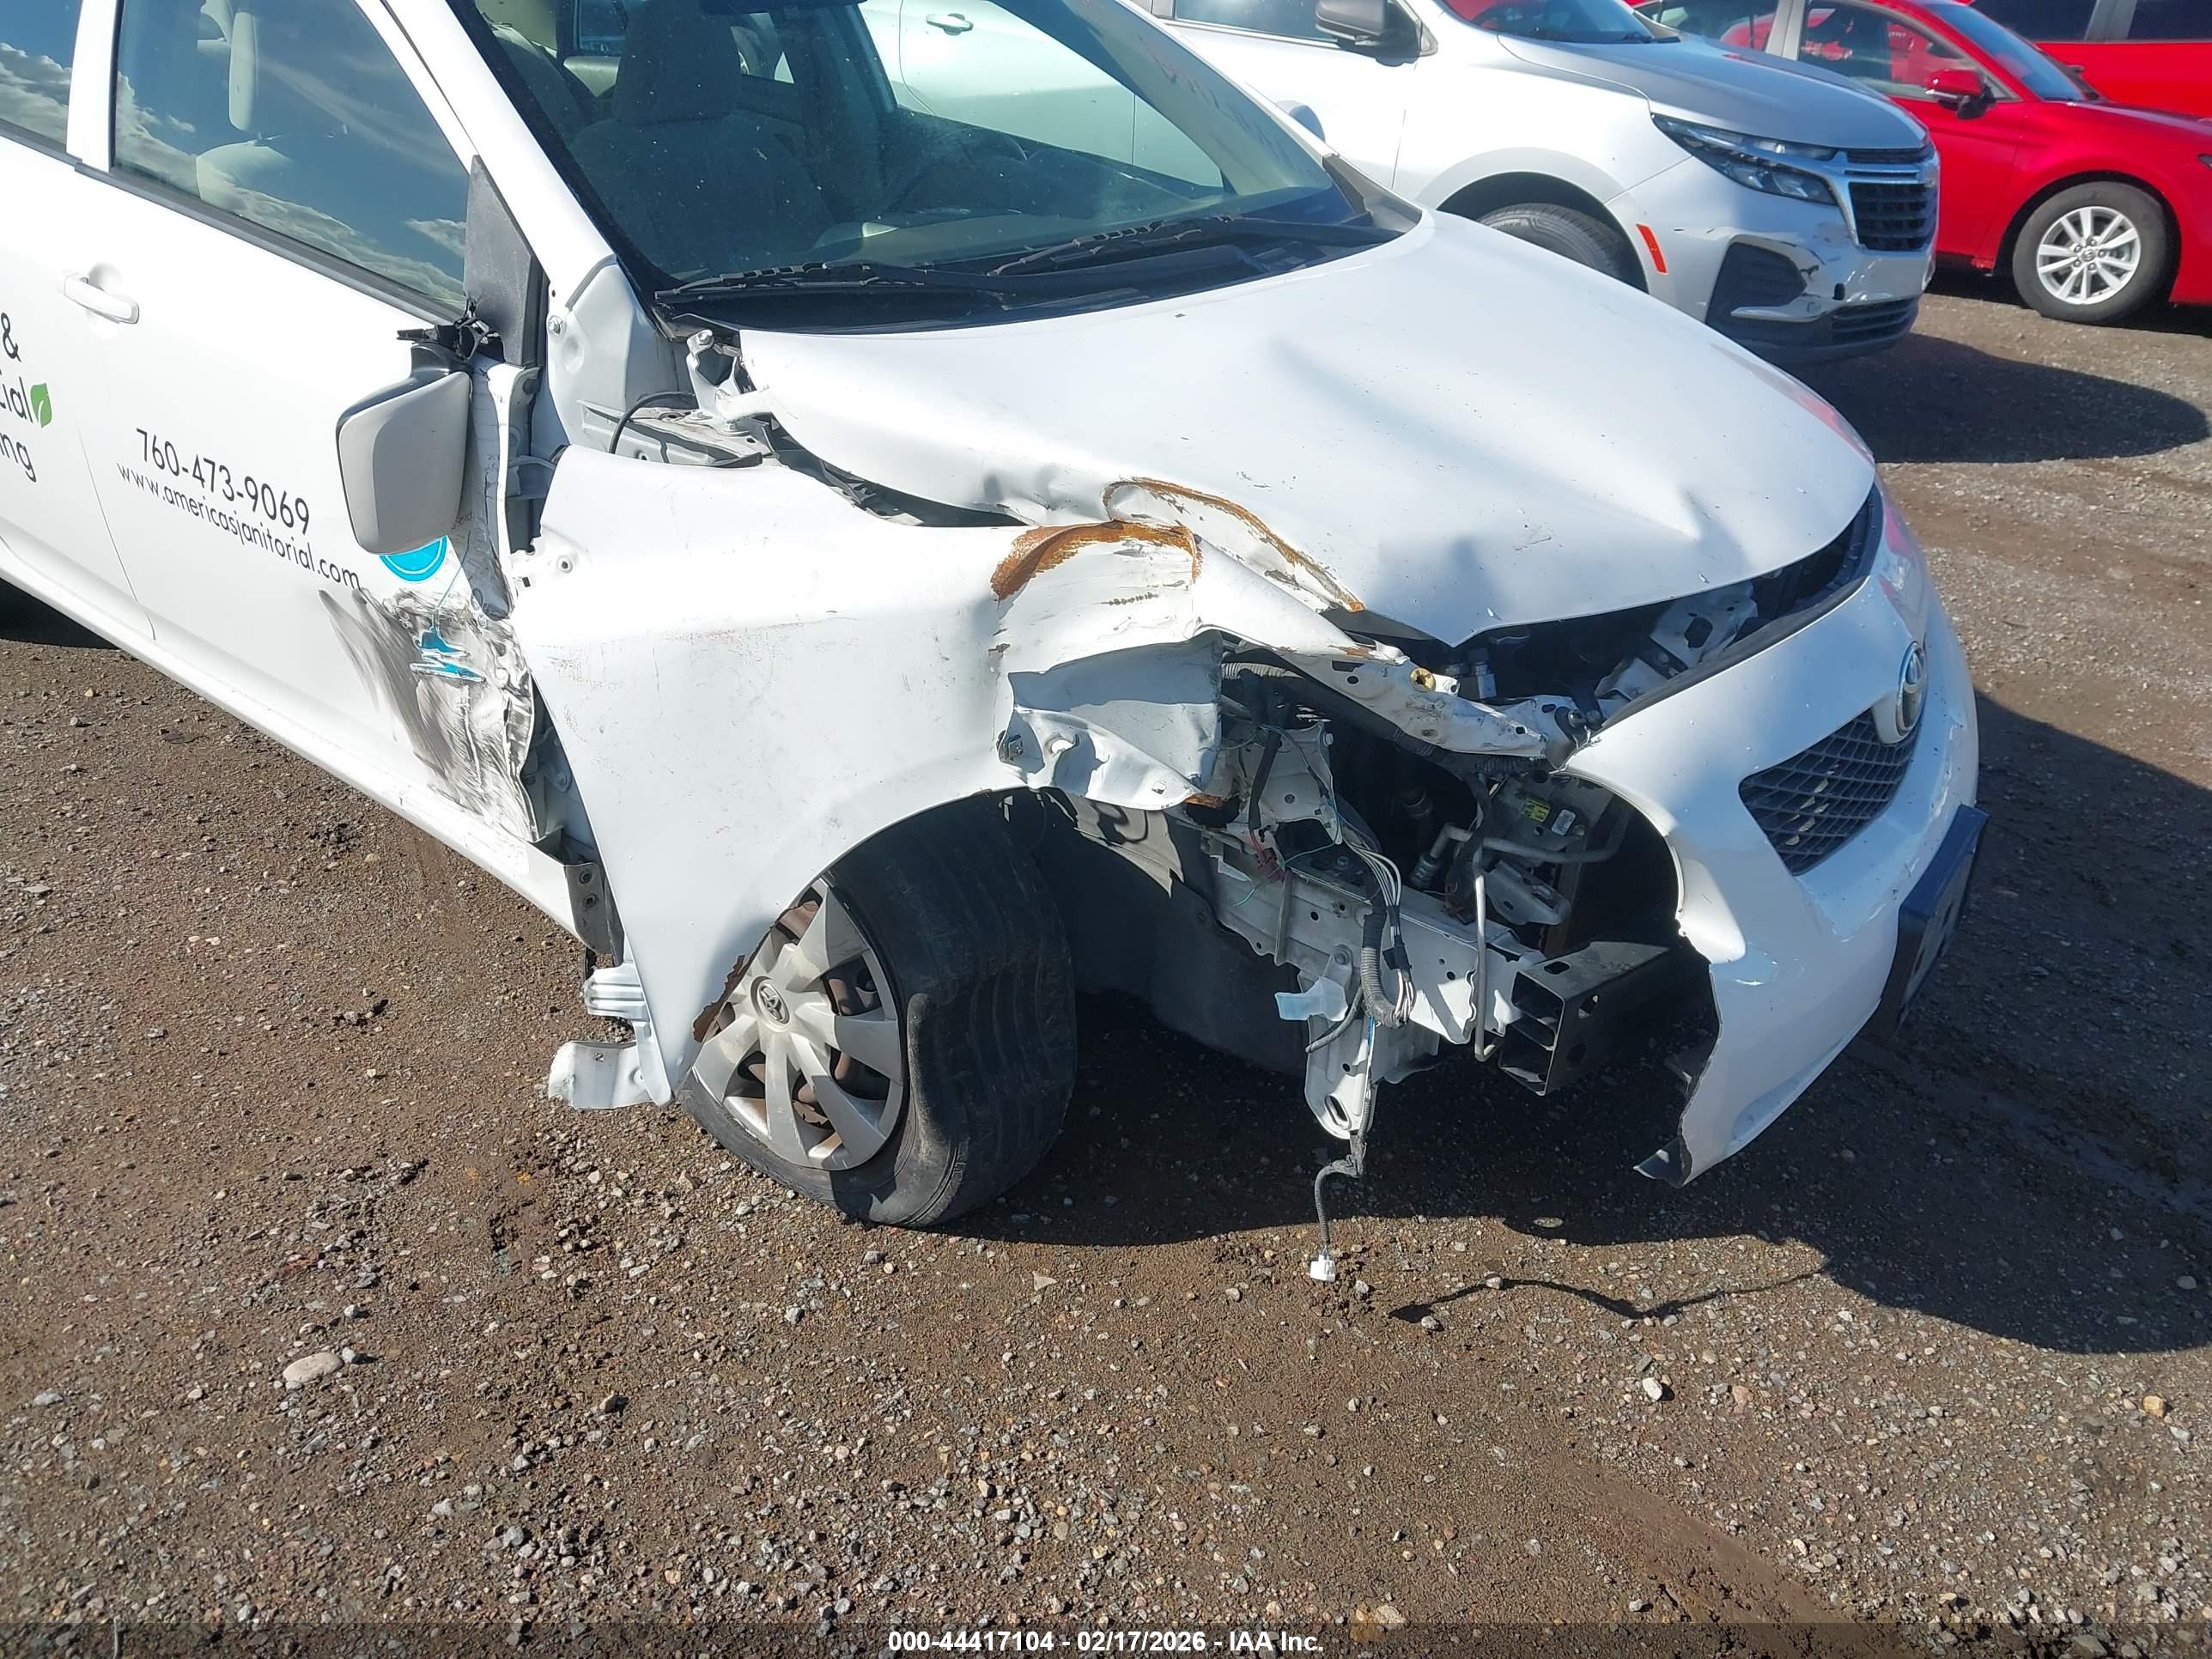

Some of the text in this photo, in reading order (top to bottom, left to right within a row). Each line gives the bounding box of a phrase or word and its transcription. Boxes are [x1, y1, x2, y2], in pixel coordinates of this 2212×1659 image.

[1, 313, 21, 362] &
[0, 367, 33, 423] ial
[137, 428, 309, 535] 760-473-9069
[117, 463, 361, 591] www.americasjanitorial.com
